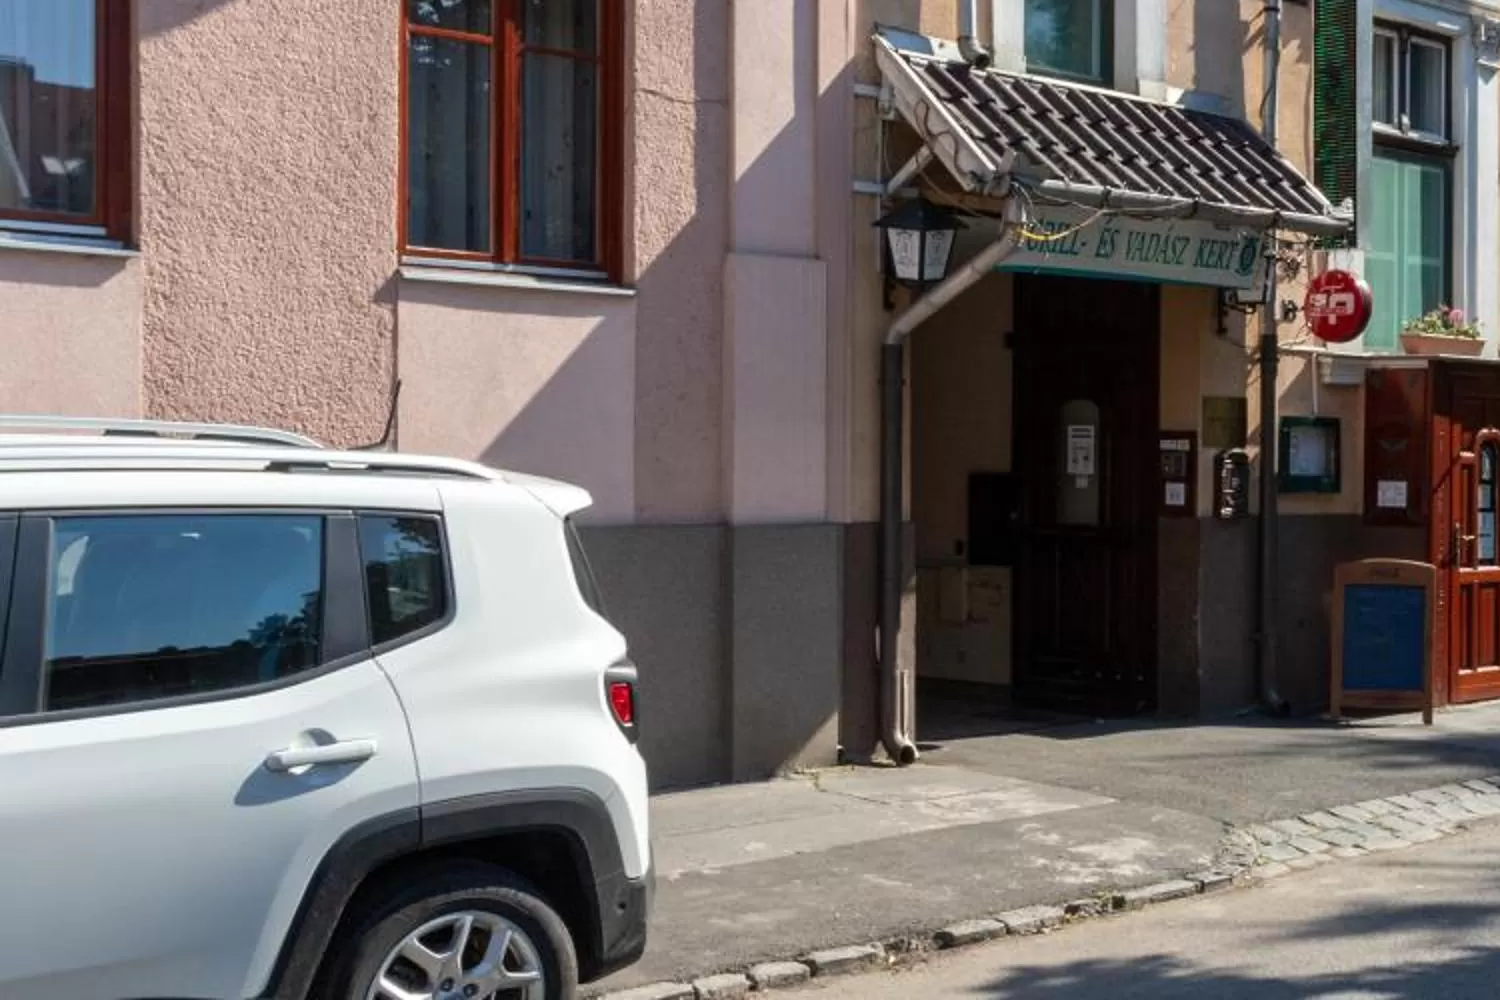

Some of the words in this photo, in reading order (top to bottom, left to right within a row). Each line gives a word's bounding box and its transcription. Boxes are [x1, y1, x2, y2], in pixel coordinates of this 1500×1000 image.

[1095, 217, 1121, 260] ÉS
[1125, 222, 1191, 266] VADÁSZ
[1193, 237, 1240, 271] KERT
